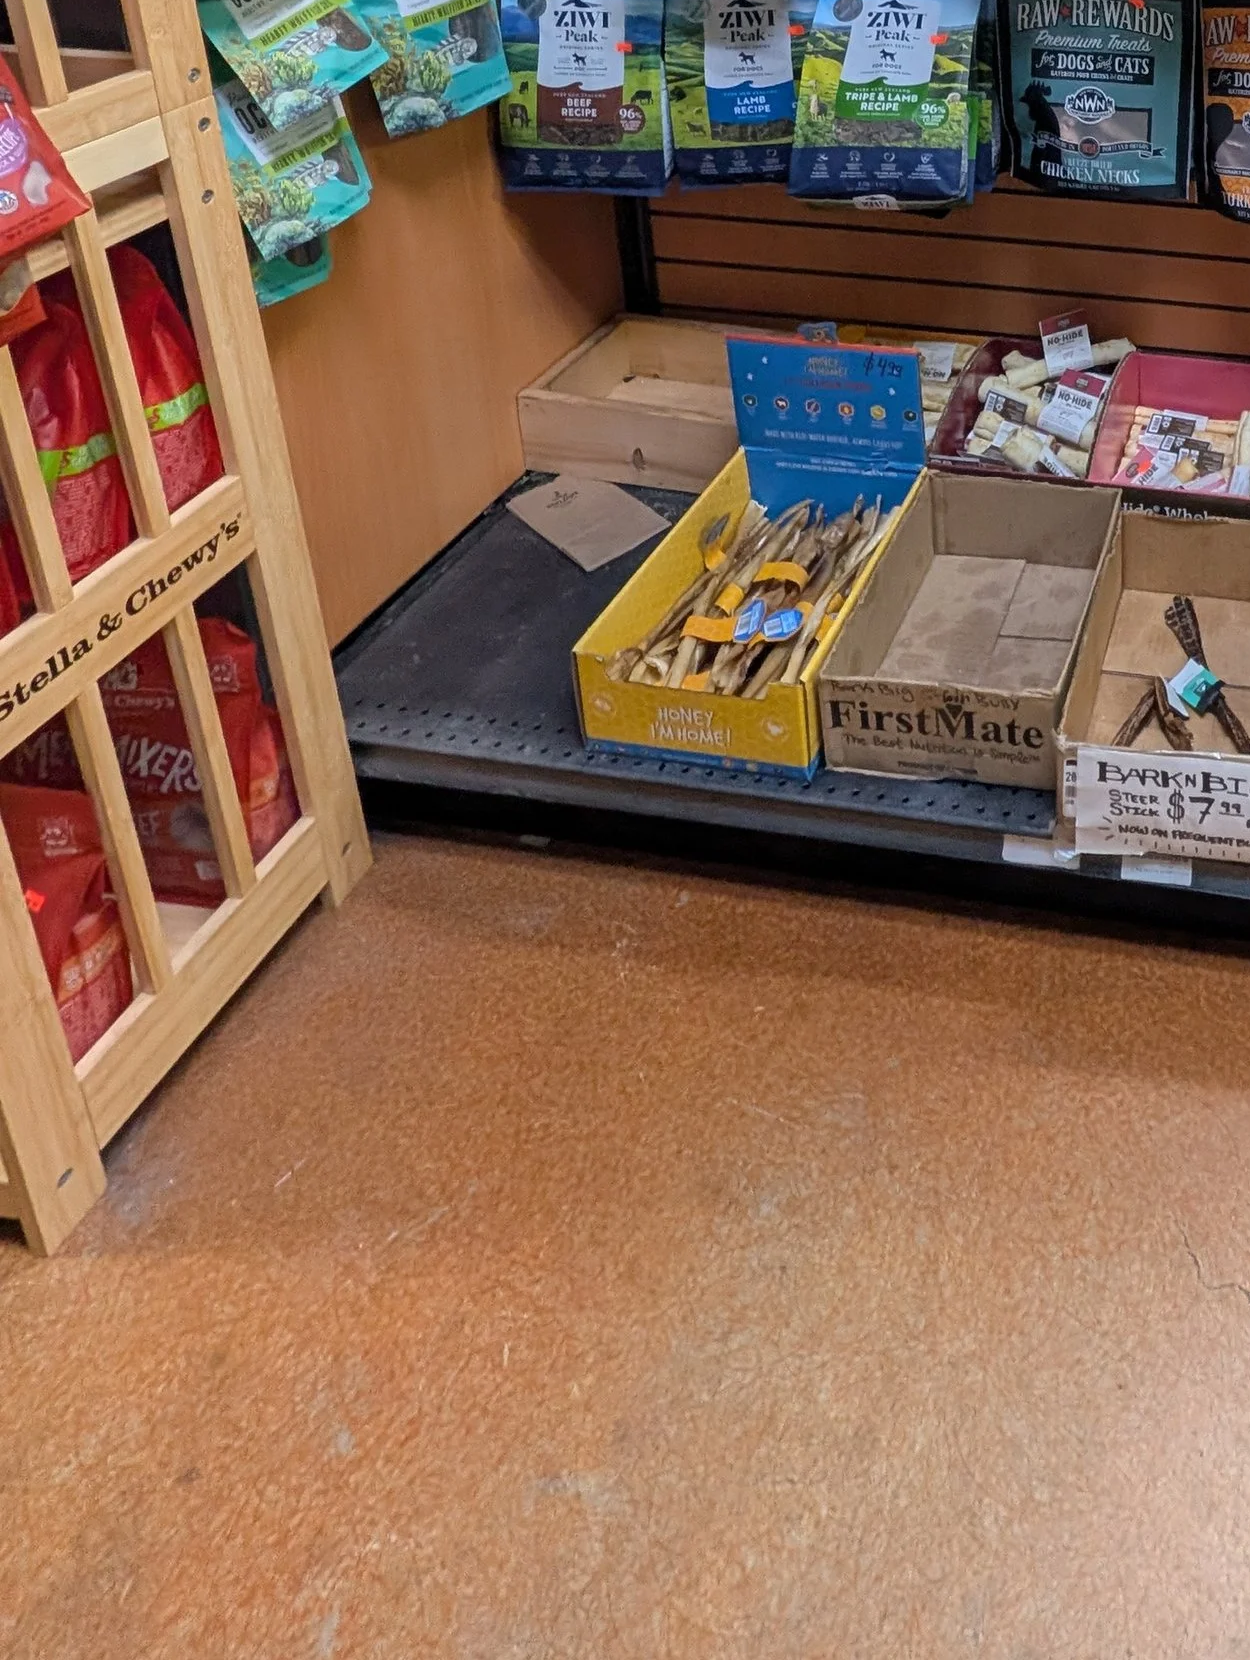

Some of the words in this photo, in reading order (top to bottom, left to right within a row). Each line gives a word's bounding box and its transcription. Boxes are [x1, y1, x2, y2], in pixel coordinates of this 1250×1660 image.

[553, 10, 612, 28] ZIWI
[718, 9, 776, 28] ZIWI
[866, 10, 927, 31] ZIWI
[1016, 0, 1068, 33] RAW
[564, 29, 598, 43] Peak
[730, 29, 766, 42] Peak
[874, 29, 912, 43] Peak
[1035, 29, 1103, 50] Premium
[1107, 31, 1153, 52] Treats
[1056, 53, 1095, 71] DOGS
[1114, 57, 1150, 75] CATS
[566, 98, 592, 108] BEEF
[736, 95, 766, 106] LAMB
[844, 92, 876, 103] TRIPE
[877, 92, 886, 101] &
[888, 94, 918, 104] LAMB
[561, 107, 598, 118] RECIPE
[734, 104, 771, 114] RECIPE
[860, 101, 899, 112] RECIPE
[1040, 159, 1096, 182] CHICKEN
[1098, 167, 1141, 184] NECKS
[0, 635, 94, 722] Stella
[96, 613, 123, 643] &
[125, 522, 241, 618] Chewy's
[657, 707, 714, 725] HONEY
[827, 700, 1045, 749] FirstMate
[687, 725, 732, 748] HOME!
[1097, 761, 1183, 788] BARK
[1184, 774, 1196, 787] N
[1109, 790, 1160, 805] STEER
[1110, 803, 1160, 817] STICK
[1119, 825, 1149, 835] NOW
[1151, 829, 1168, 838] ON
